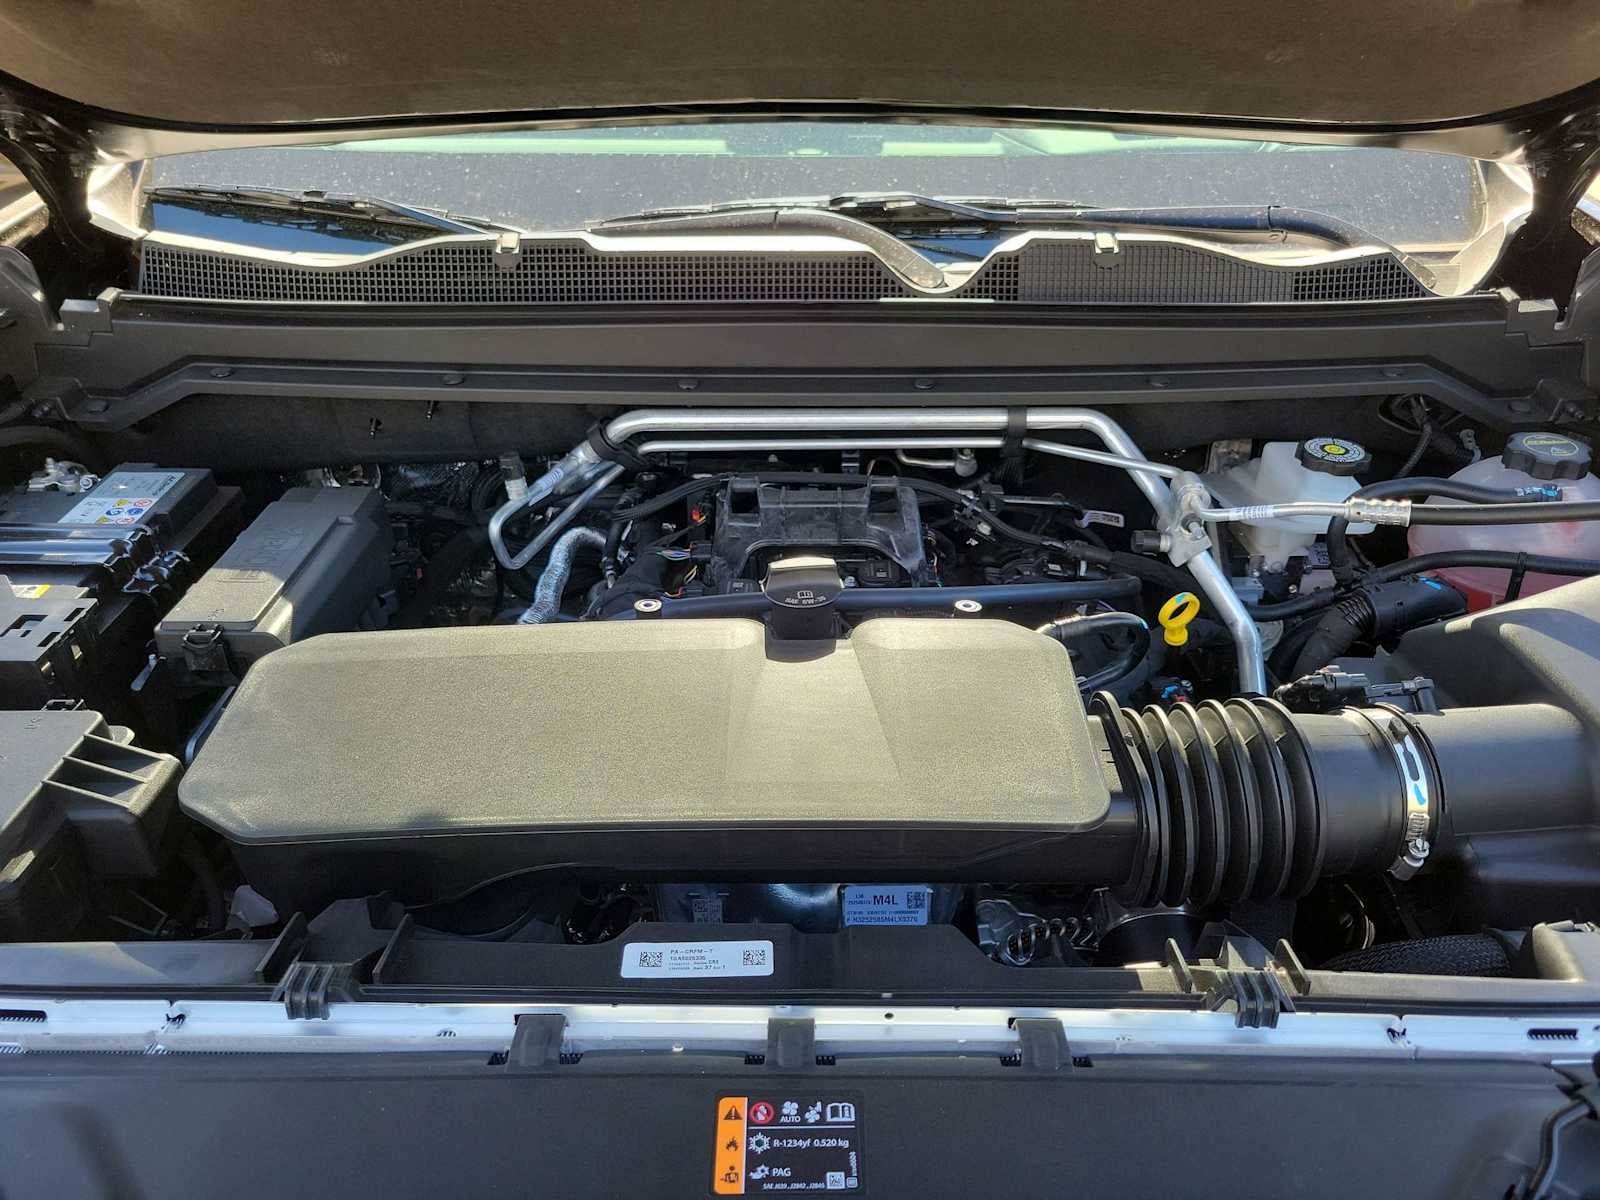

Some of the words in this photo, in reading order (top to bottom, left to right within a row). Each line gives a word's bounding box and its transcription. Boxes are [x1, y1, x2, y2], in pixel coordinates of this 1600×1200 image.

[873, 894, 898, 906] M4L
[780, 1115, 801, 1123] AUTO
[773, 1139, 811, 1149] R-1234yf
[813, 1138, 837, 1148] 0.520
[838, 1138, 849, 1149] kg
[772, 1167, 791, 1177] PAG
